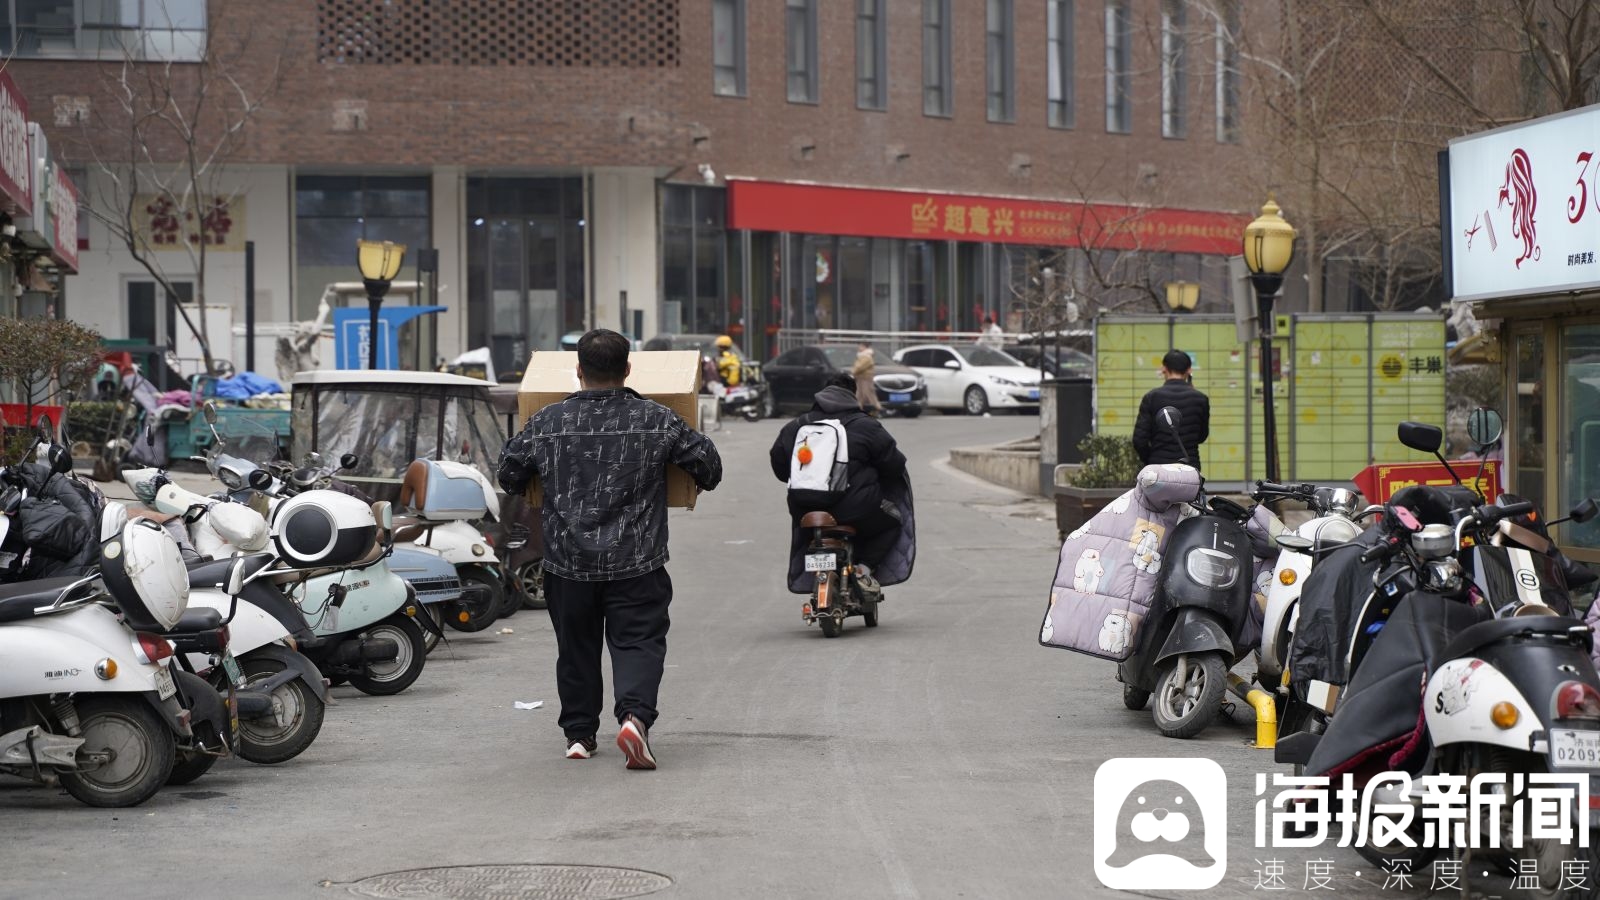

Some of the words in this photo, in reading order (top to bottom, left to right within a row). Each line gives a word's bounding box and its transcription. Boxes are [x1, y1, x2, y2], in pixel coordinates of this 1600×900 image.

[944, 205, 1014, 236] 超意兴
[1409, 356, 1442, 374] 丰巢
